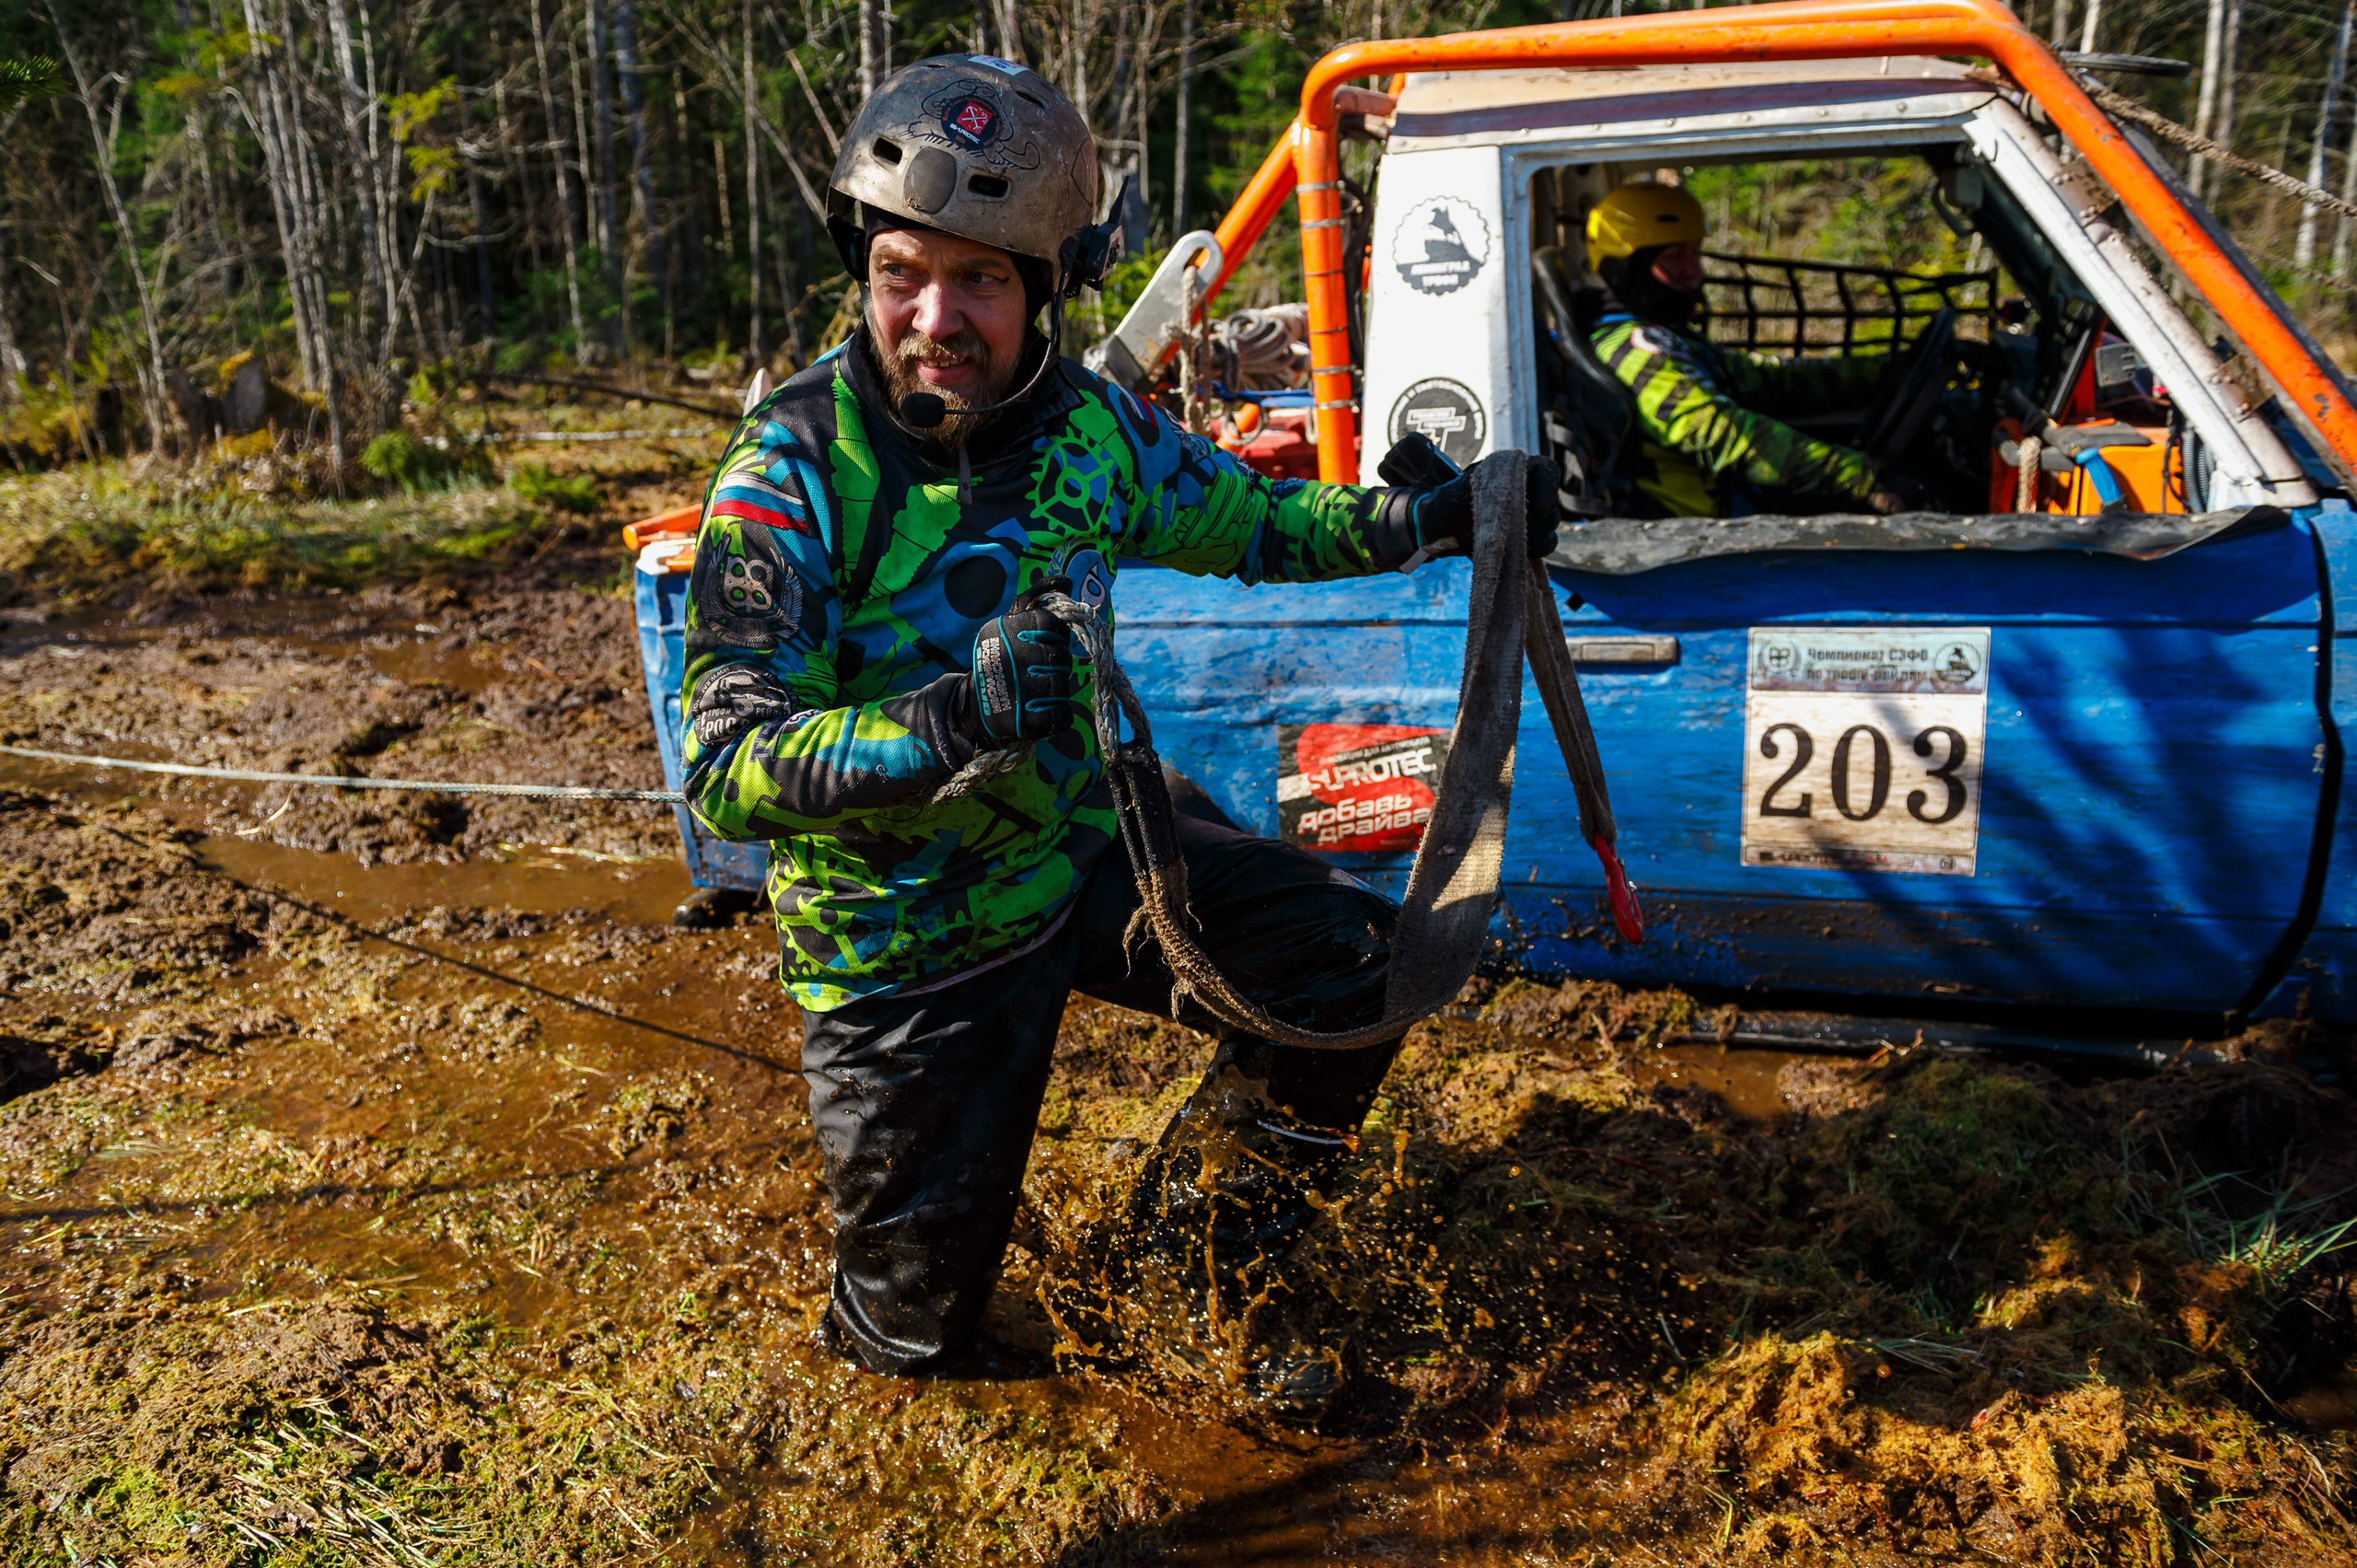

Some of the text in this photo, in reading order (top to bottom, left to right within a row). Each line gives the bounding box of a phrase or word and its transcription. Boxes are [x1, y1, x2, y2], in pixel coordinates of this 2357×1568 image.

[976, 646, 992, 716] GROSS
[981, 638, 1003, 714] MECHANISCHE
[989, 636, 1013, 712] HANDSCHUHE
[1807, 647, 1885, 661] Чемпионат
[1759, 723, 1968, 824] 203
